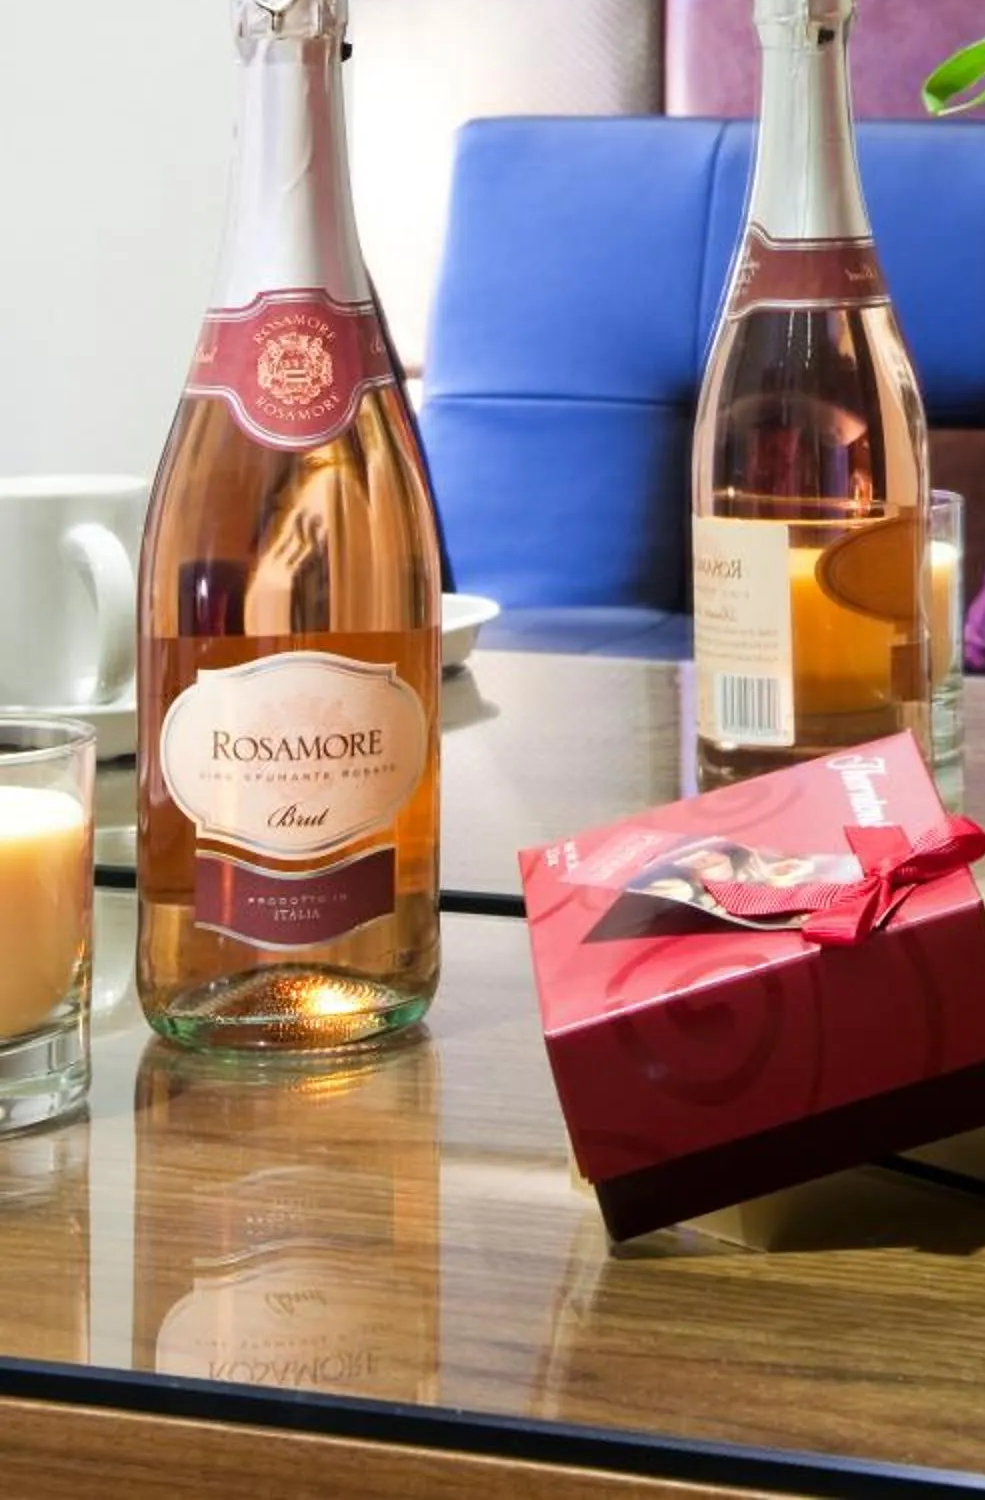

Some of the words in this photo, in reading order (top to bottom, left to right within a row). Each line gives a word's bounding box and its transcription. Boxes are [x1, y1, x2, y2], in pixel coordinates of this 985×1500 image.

[253, 313, 336, 344] ROSAMORE
[256, 392, 340, 420] ROSAMORE
[211, 729, 385, 763] ROSAMORE
[267, 803, 329, 829] Brut
[273, 907, 321, 921] ITALIA
